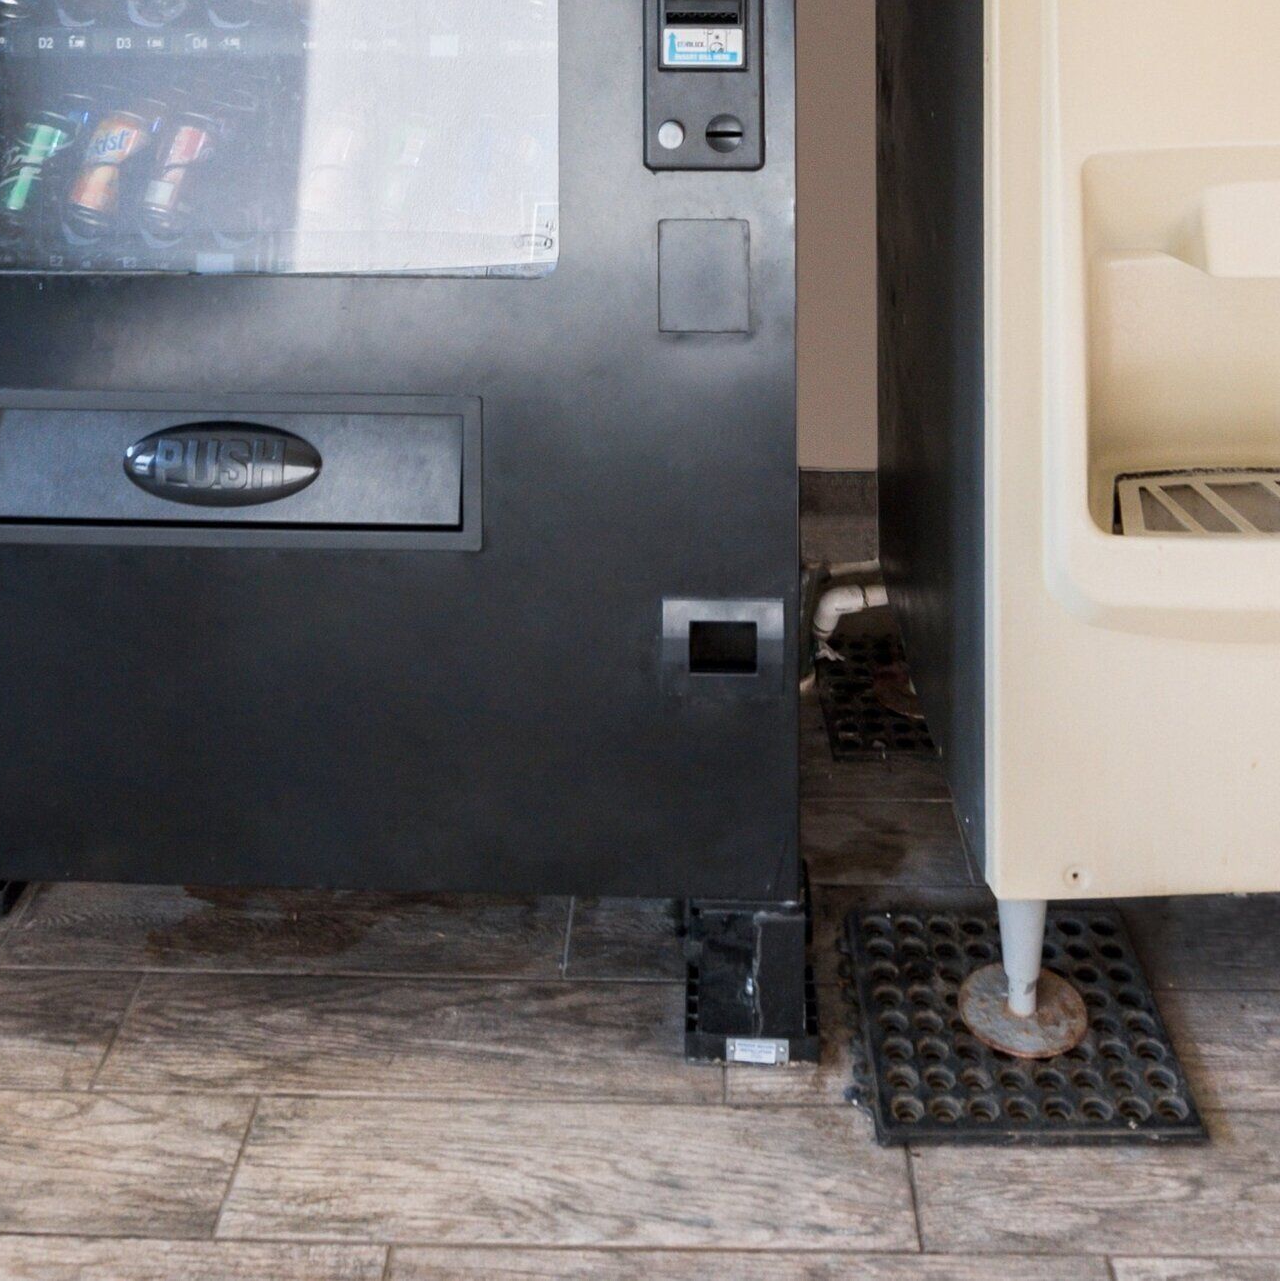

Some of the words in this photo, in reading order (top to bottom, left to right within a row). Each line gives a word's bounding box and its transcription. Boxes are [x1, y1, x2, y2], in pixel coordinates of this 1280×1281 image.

[38, 37, 54, 49] D2
[116, 37, 131, 49] D3
[192, 37, 208, 49] D4
[154, 438, 286, 490] PUSH
